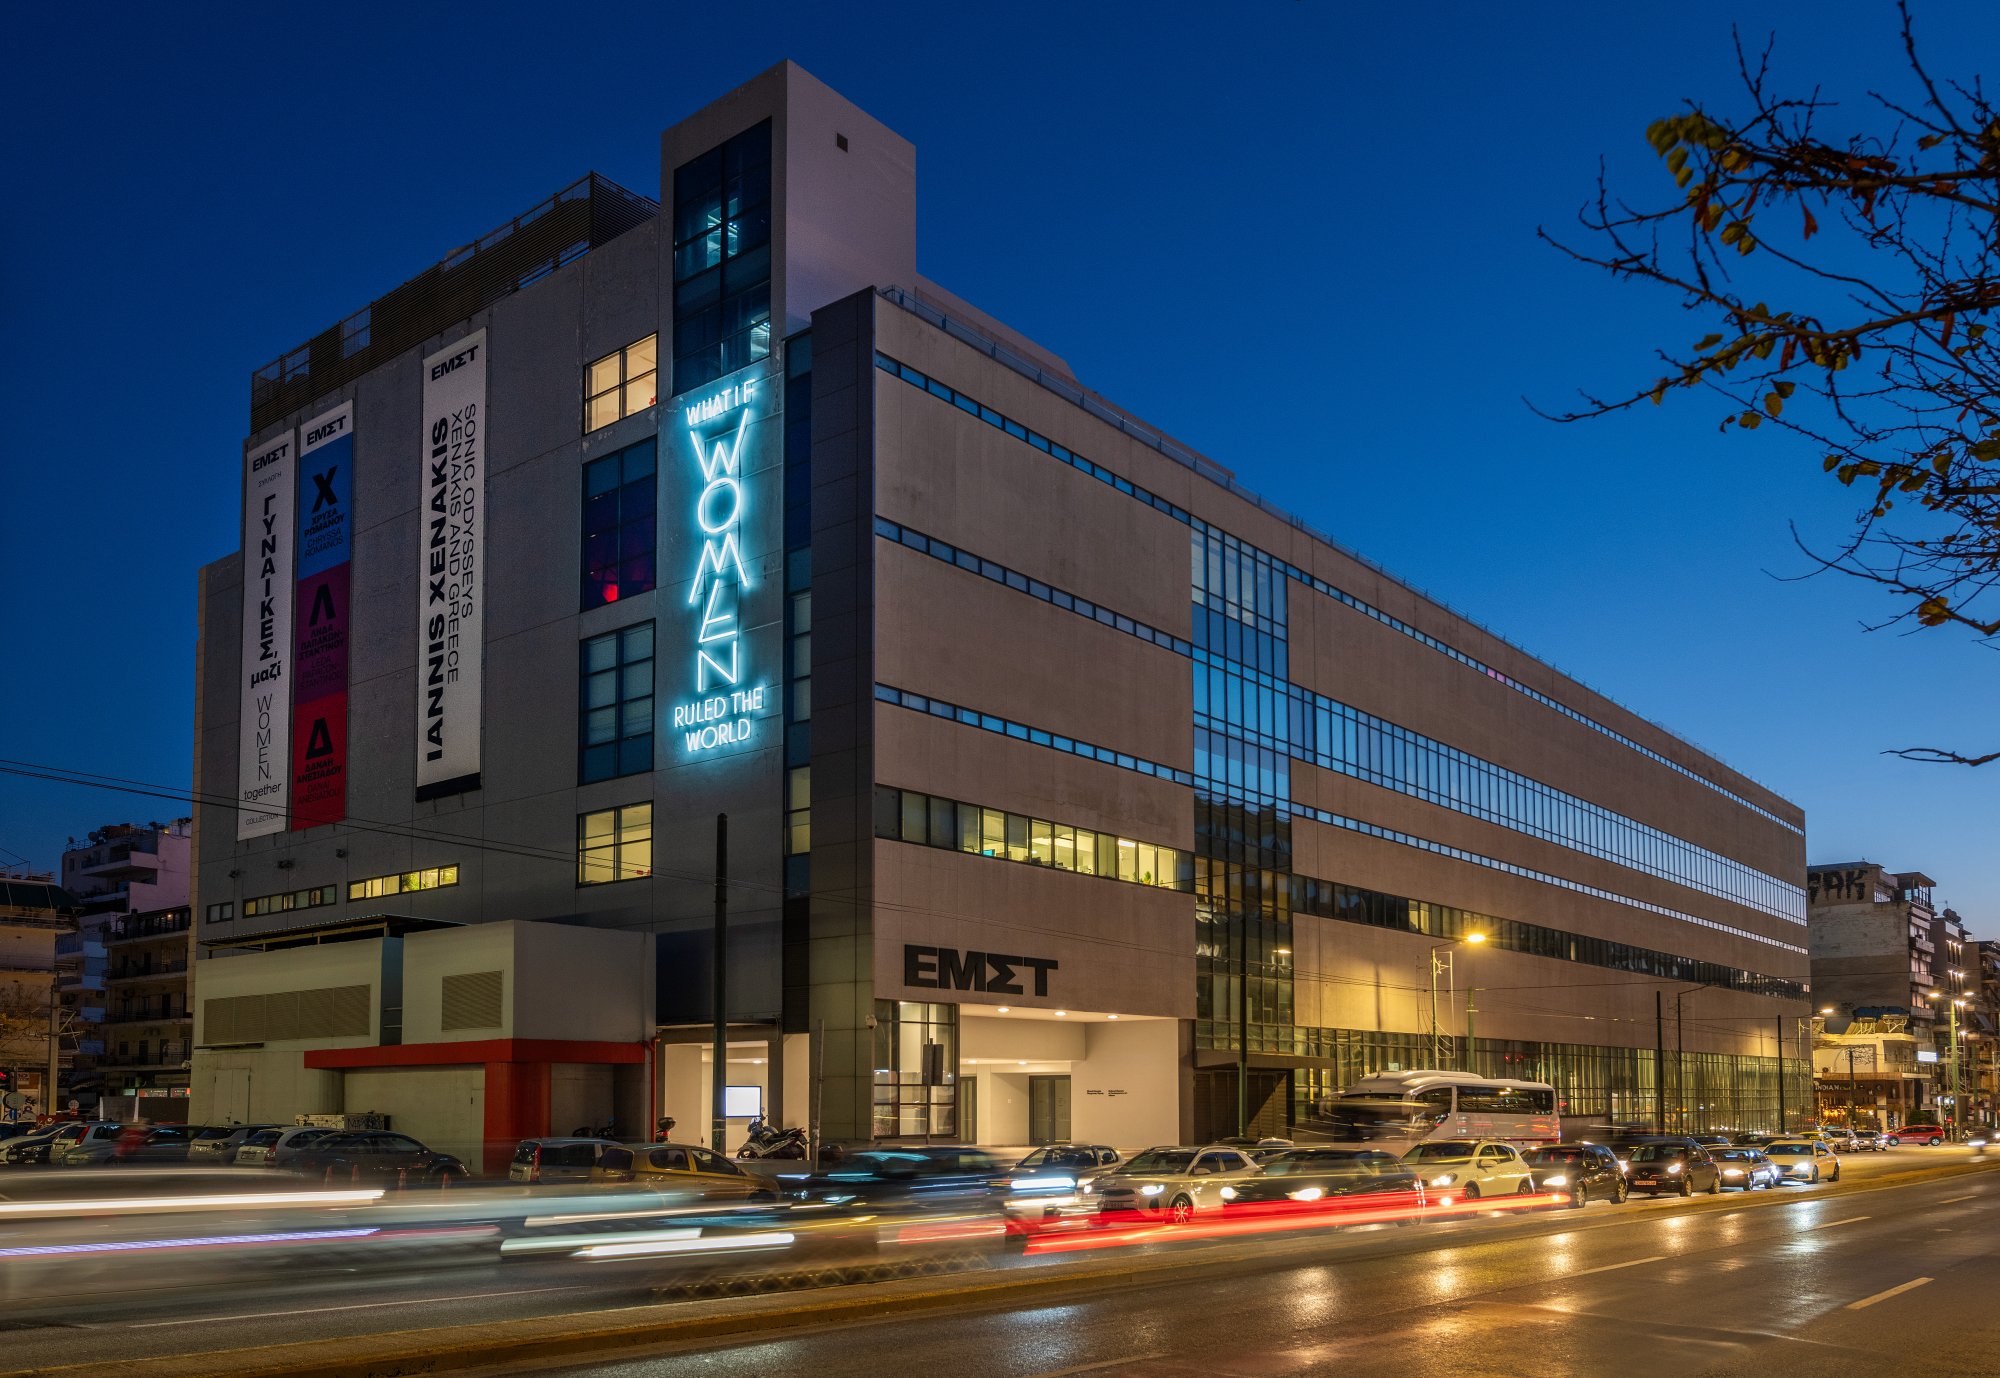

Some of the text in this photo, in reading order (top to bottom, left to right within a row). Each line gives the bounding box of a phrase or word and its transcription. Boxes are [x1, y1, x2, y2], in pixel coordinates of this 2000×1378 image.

[431, 345, 479, 381] ΕΜΣΤ
[686, 379, 756, 426] WHAT IF
[307, 415, 347, 446] ΕΜΣΤ
[253, 443, 288, 472] ΕΜΣΤ
[461, 403, 476, 618] SONIC ODYSSEYS
[307, 528, 341, 548] CHRYSSA
[447, 409, 463, 684] XENAKIS AND GREECE
[689, 408, 749, 692] WOMEN
[427, 417, 449, 762] IANNIS XENAKIS
[251, 660, 281, 689] μαζί
[674, 687, 763, 727] RULED THE
[685, 718, 751, 752] WORLD
[244, 783, 282, 800] together
[246, 812, 278, 825] COLLECTION
[904, 944, 1059, 997] ΕΜΣΤ
